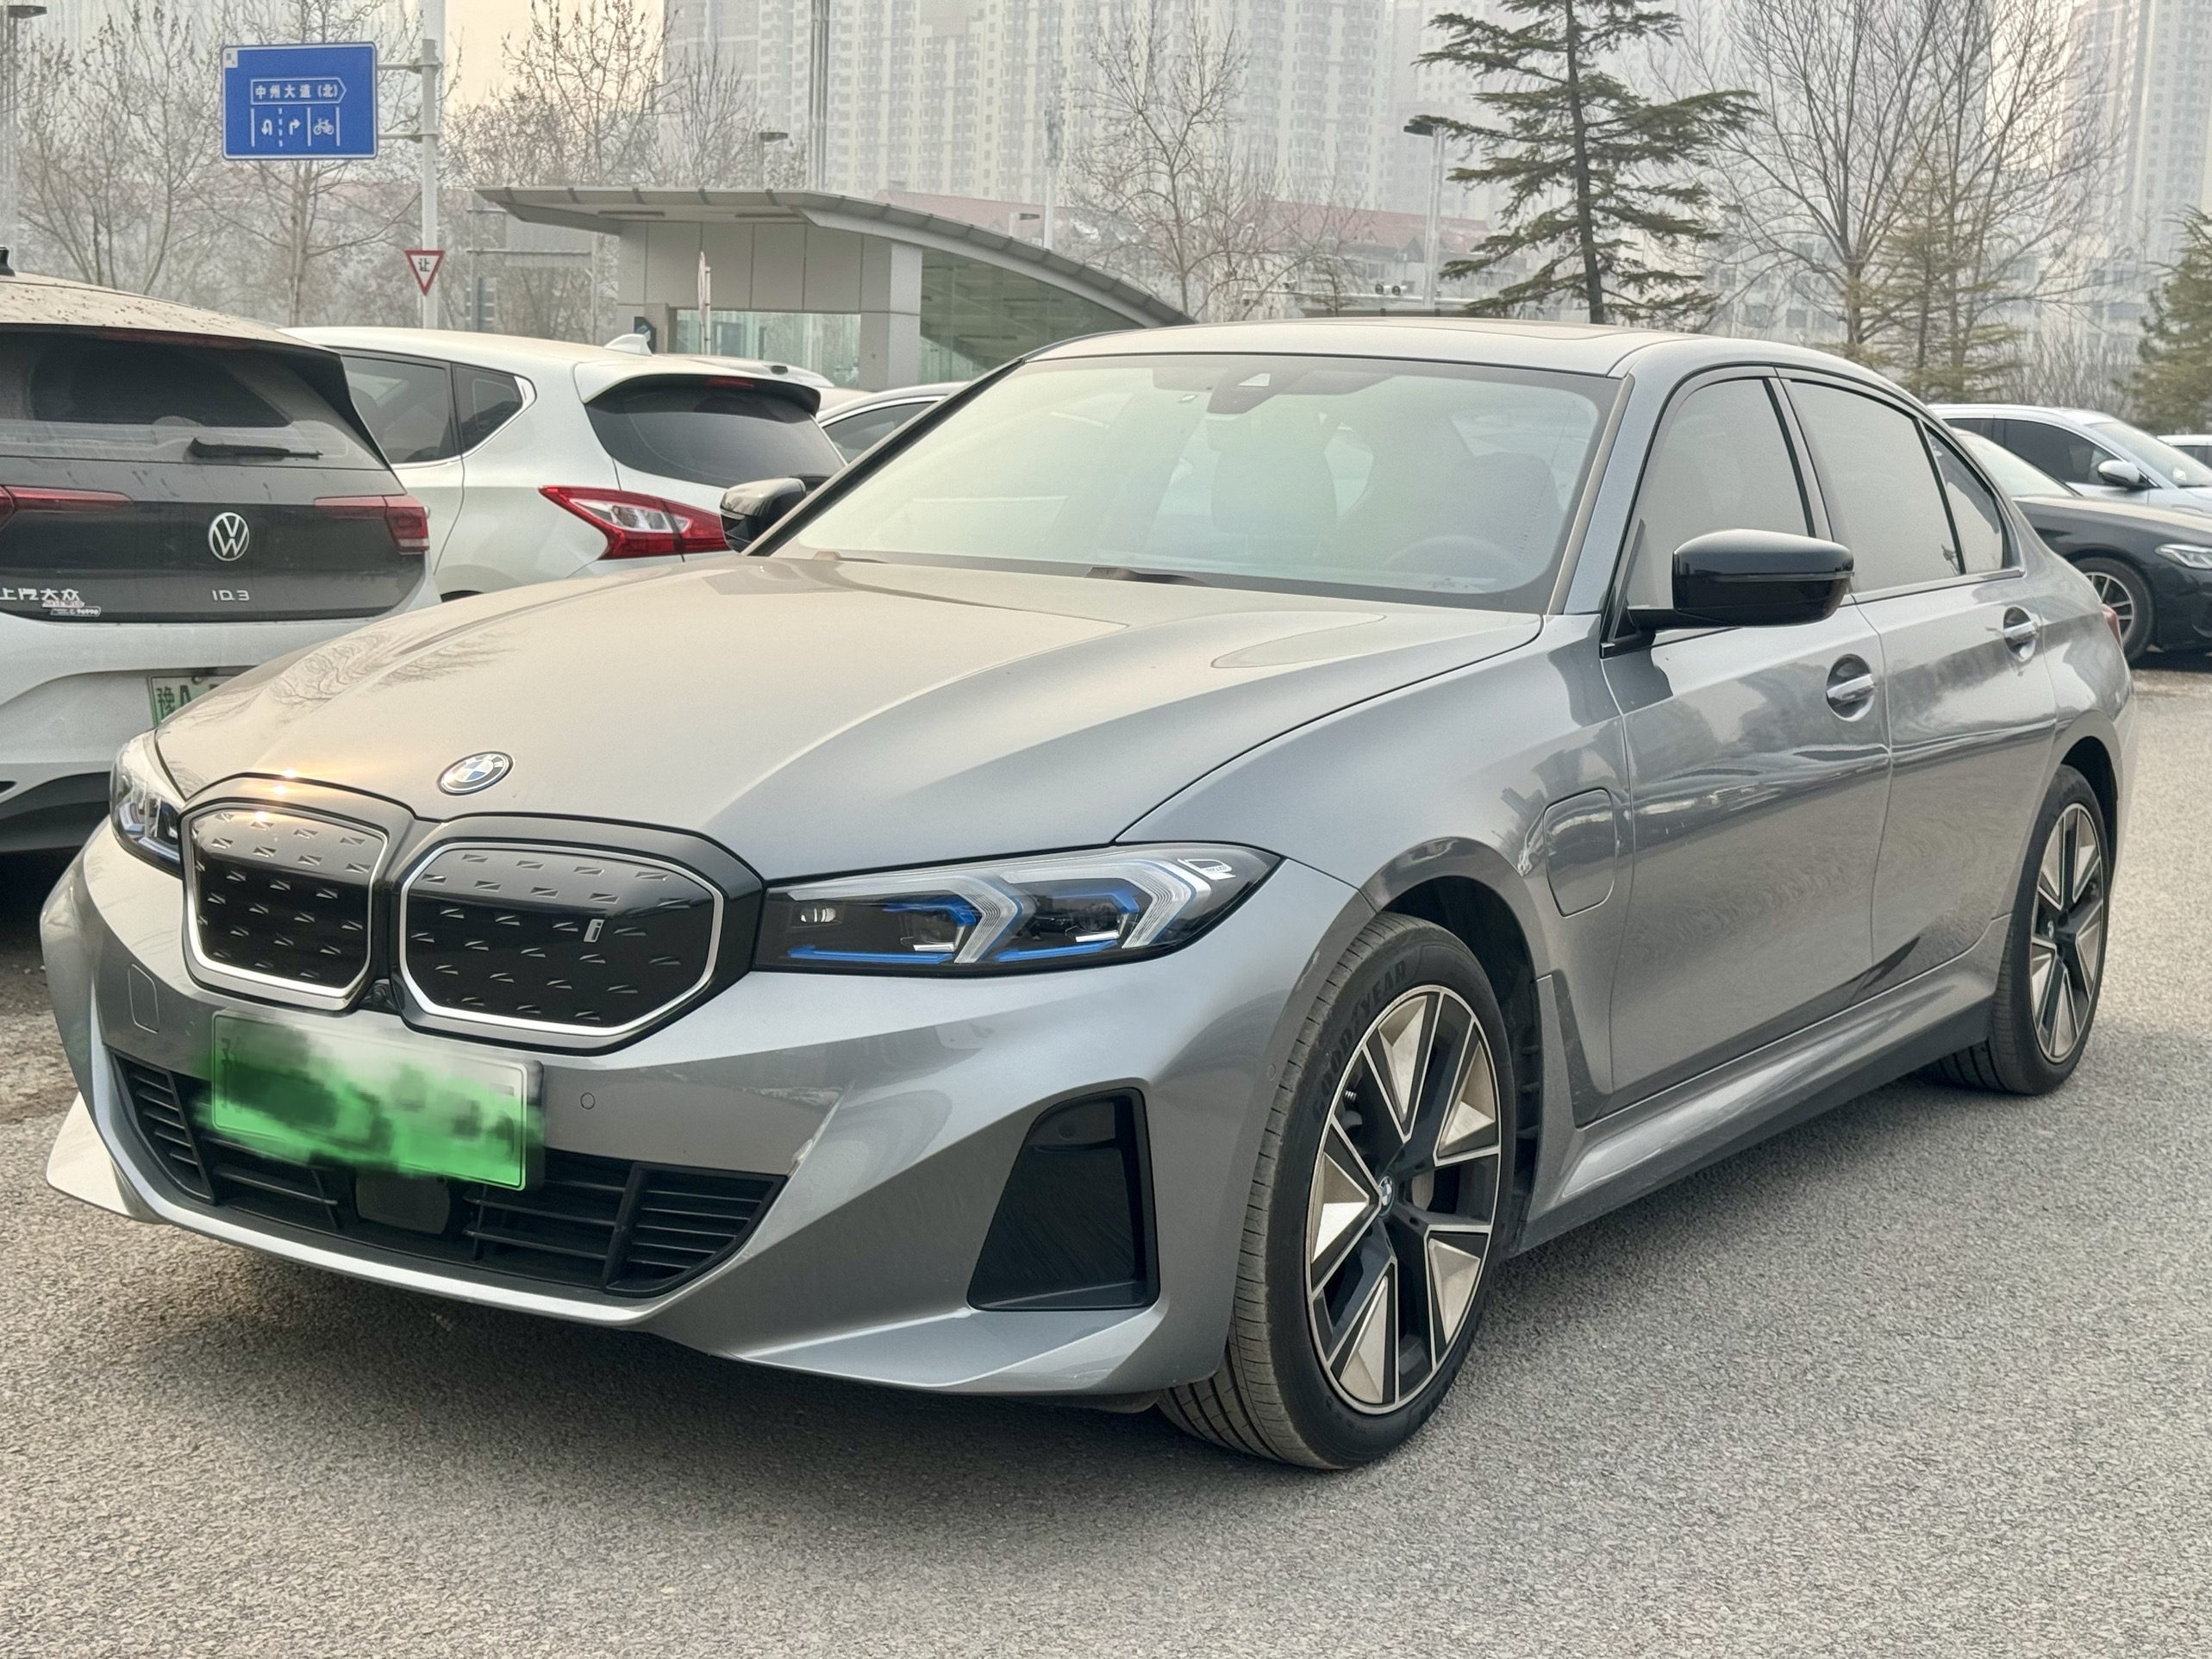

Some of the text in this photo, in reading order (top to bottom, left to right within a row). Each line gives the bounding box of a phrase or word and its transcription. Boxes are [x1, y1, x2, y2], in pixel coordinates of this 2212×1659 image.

[418, 258, 430, 272] 让
[0, 587, 81, 602] 上汽大众
